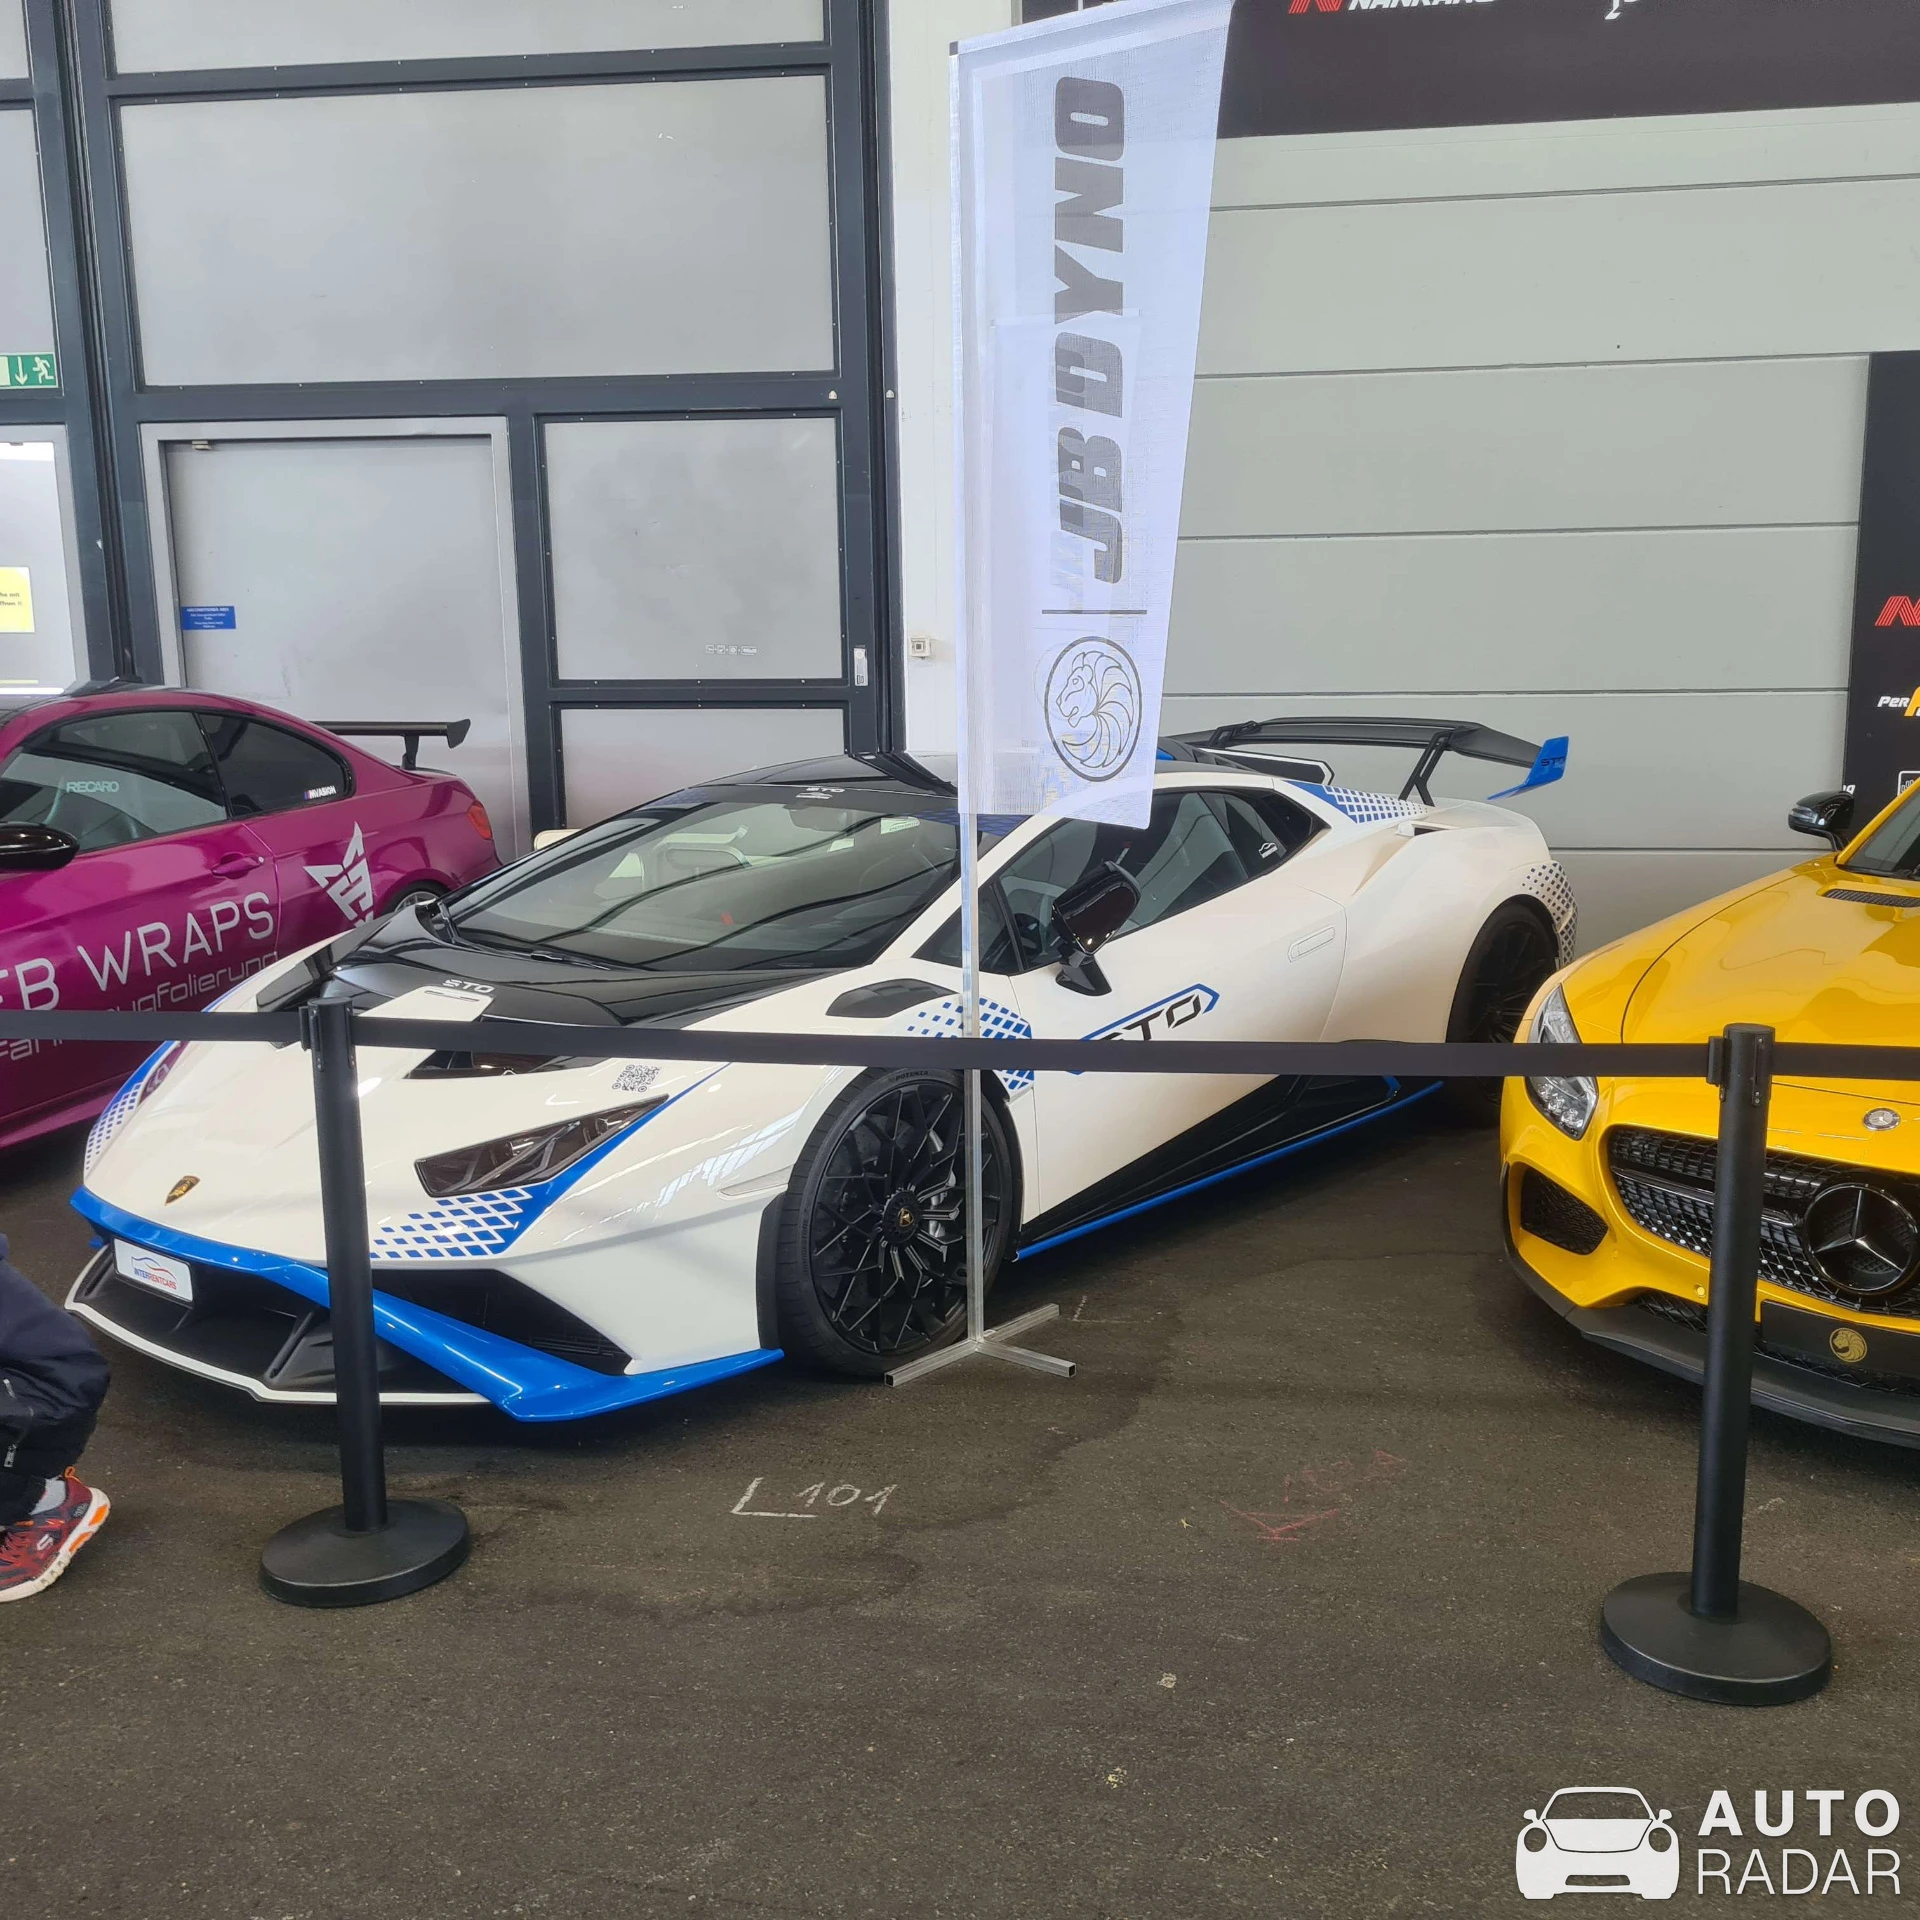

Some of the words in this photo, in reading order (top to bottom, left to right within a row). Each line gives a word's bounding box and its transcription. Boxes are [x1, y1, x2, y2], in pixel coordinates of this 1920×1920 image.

[1054, 76, 1124, 418] DYNO
[1058, 427, 1123, 584] JB
[66, 781, 120, 793] RECARO
[77, 891, 275, 992] WRAPS
[442, 979, 496, 993] STO
[794, 1481, 898, 1516] 101
